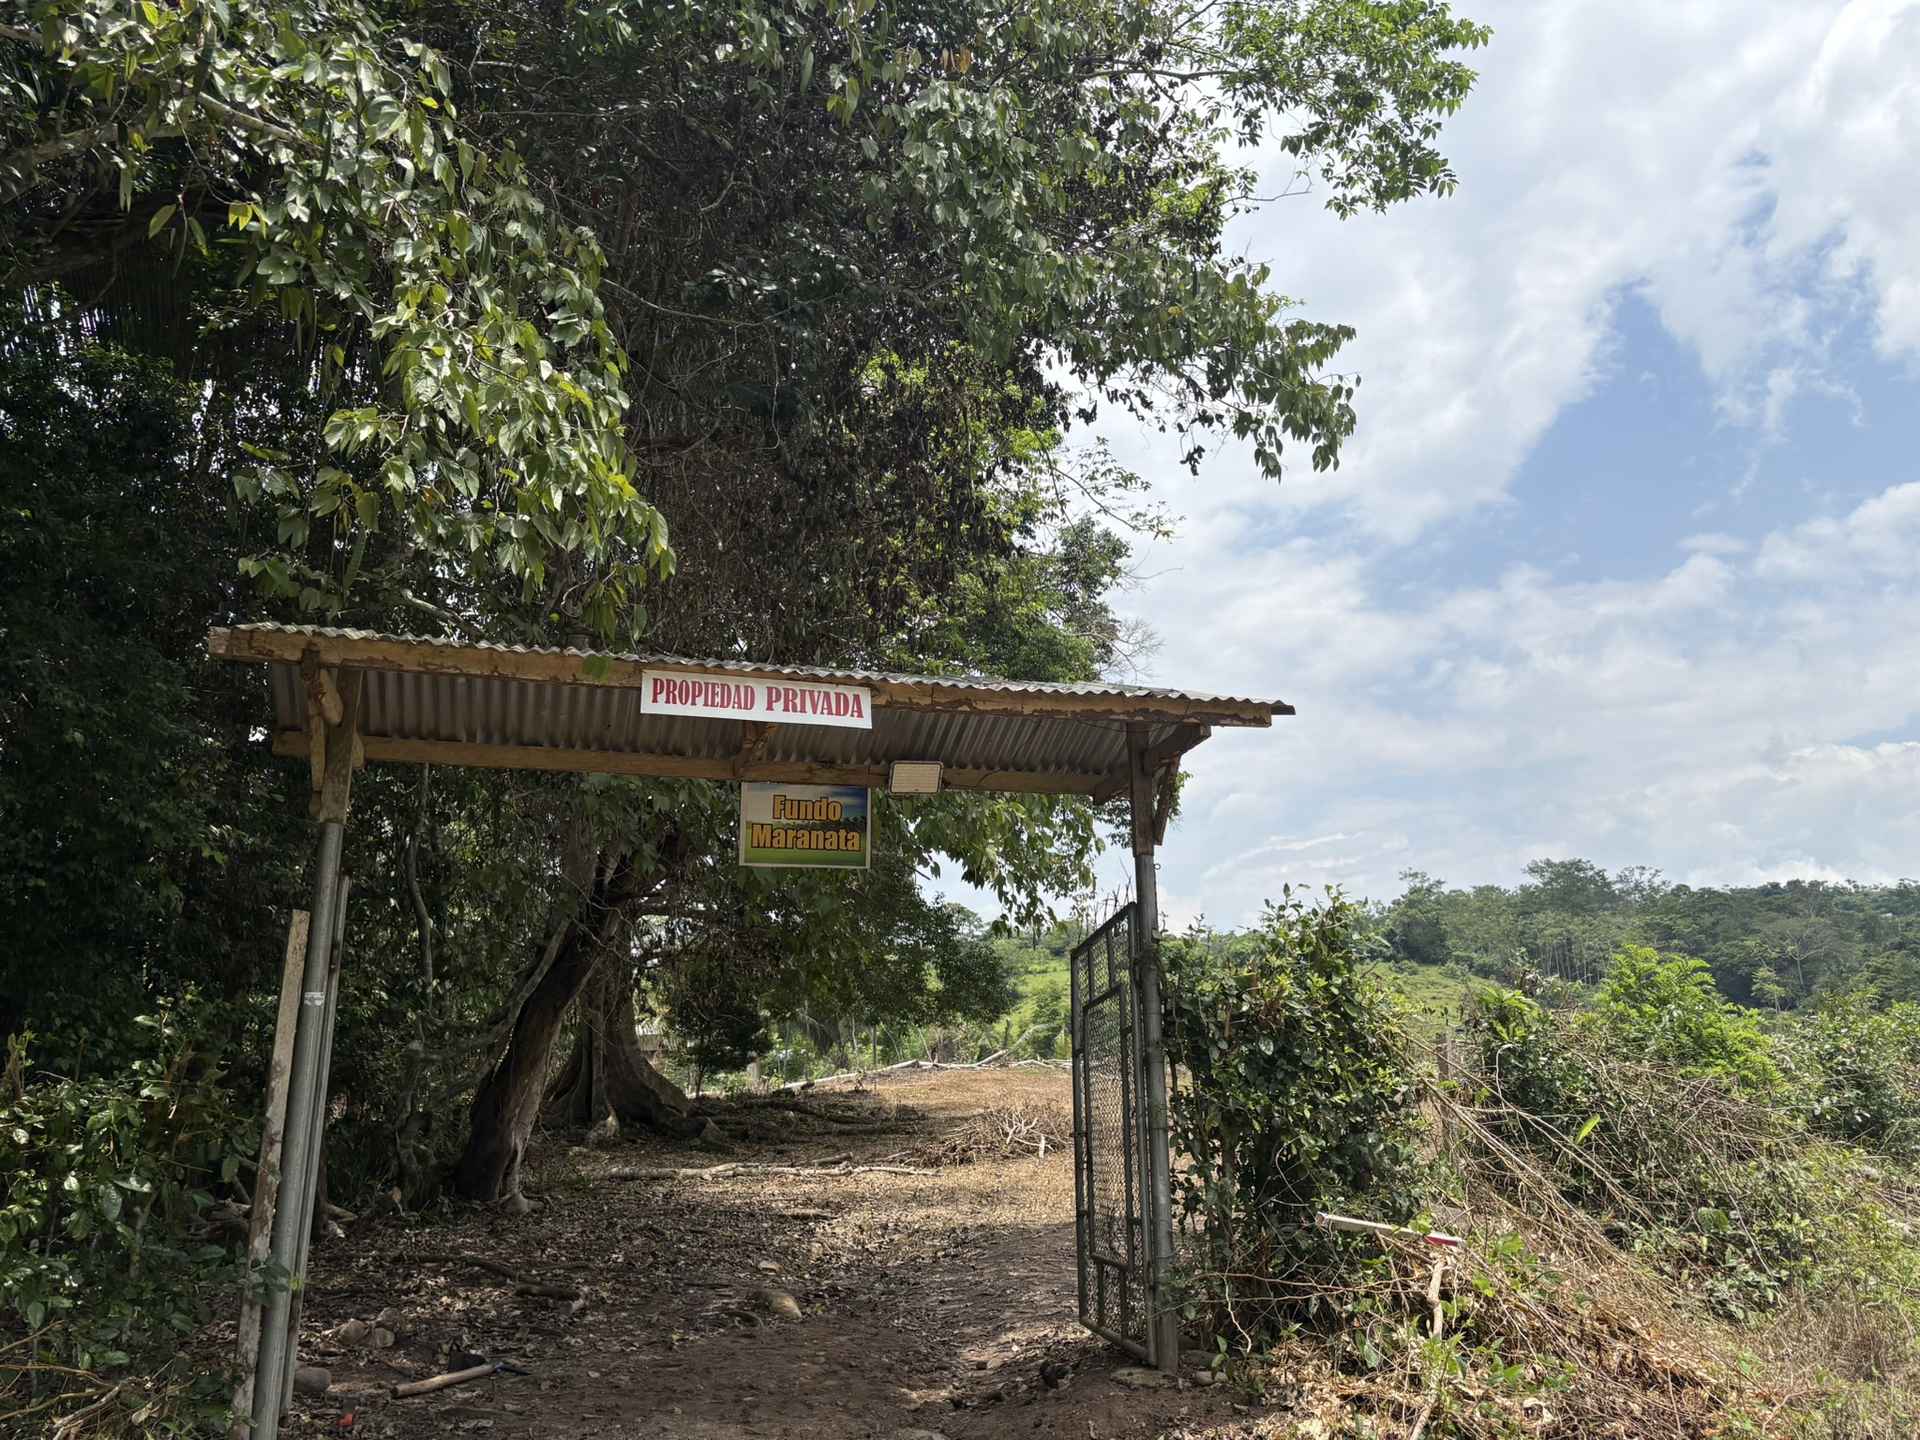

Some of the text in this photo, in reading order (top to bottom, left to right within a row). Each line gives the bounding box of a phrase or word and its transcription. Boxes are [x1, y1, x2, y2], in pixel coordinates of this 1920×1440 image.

[652, 678, 864, 718] PROPIEDAD PRIVADA
[772, 795, 842, 821] Fundo
[751, 823, 862, 851] Maranata
